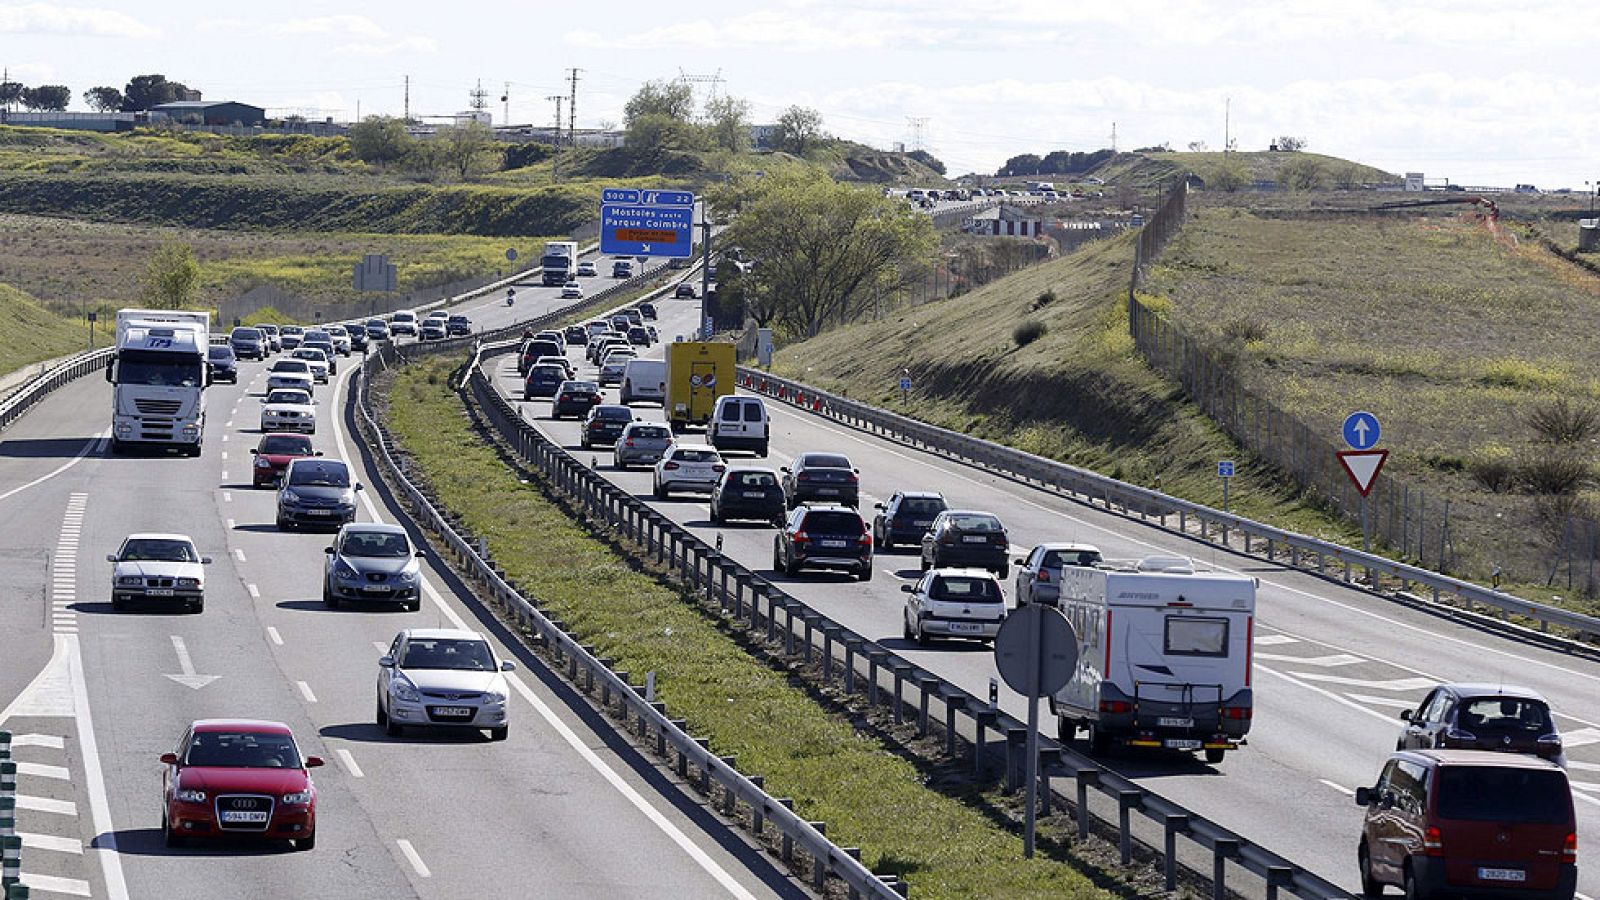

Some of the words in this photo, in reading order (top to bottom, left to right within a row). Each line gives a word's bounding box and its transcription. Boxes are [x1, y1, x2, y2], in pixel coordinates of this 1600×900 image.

[606, 192, 625, 200] 500
[676, 195, 689, 203] 22
[605, 219, 641, 228] Parque
[646, 221, 688, 229] Coimbra
